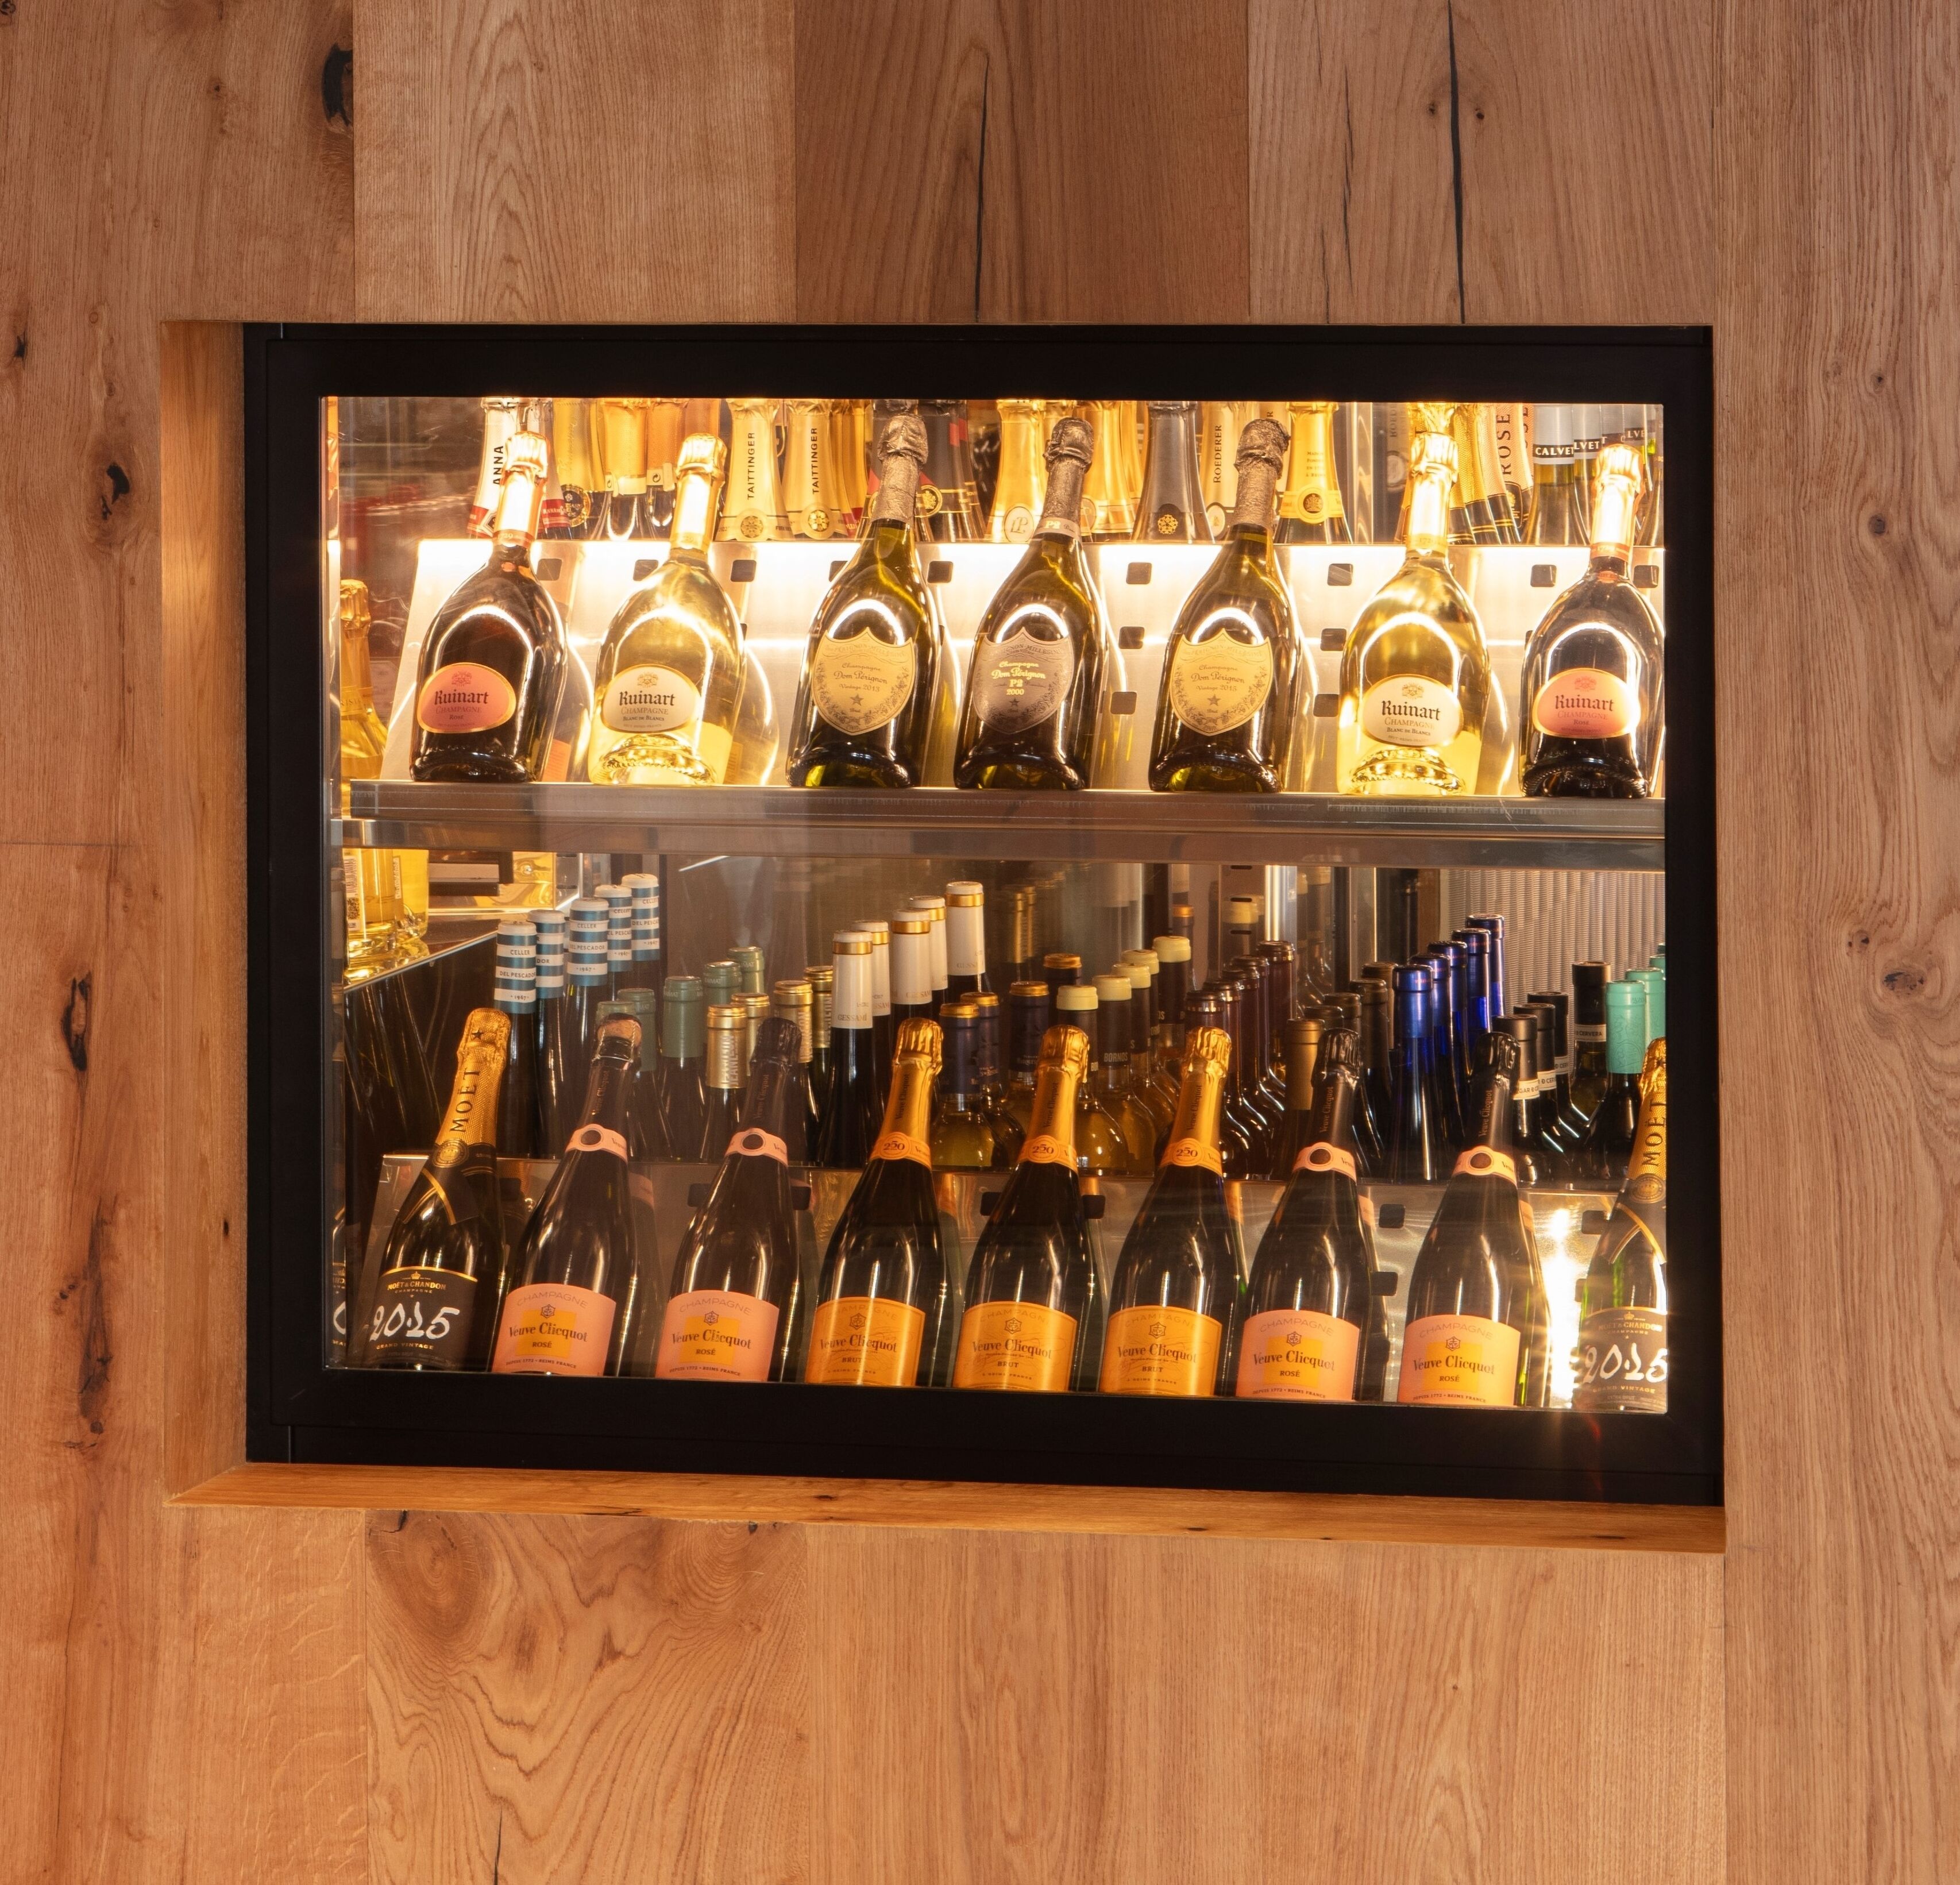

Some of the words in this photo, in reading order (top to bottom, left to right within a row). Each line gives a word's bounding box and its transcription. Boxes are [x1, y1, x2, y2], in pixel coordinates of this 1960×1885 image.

[1574, 441, 1600, 450] LVET
[1213, 425, 1222, 483] ROEDERER
[834, 670, 852, 680] Dom
[854, 670, 888, 684] Pérignon
[991, 669, 1010, 679] Dom
[1191, 673, 1209, 682] Dom
[1210, 671, 1245, 684] Pérignon
[434, 689, 489, 705] Ruinart
[619, 691, 676, 706] Ruinart
[1555, 694, 1614, 711] Ruinart
[621, 706, 669, 715] CHAMPAGNE
[1382, 700, 1441, 720] Ruinart
[1104, 1053, 1128, 1062] BORNOS
[883, 1140, 905, 1151] 250
[1032, 1144, 1054, 1154] 250
[1177, 1147, 1198, 1158] 250
[410, 1281, 446, 1290] CHANDON
[516, 1292, 589, 1309] CHAMPAGNE
[680, 1298, 752, 1316] CHAMPAGNE
[509, 1325, 536, 1338] Veuve
[539, 1322, 588, 1342] Clicquot
[1260, 1318, 1334, 1336] CHAMPAGNE
[1419, 1323, 1494, 1340] CHAMPAGNE
[1623, 1322, 1663, 1332] CHAND
[672, 1332, 700, 1344] Veuve
[703, 1329, 752, 1349] Clicquot
[820, 1338, 847, 1350] Veuve
[849, 1334, 897, 1352] Clicquot
[972, 1341, 1002, 1352] Veuve
[1005, 1338, 1053, 1359] Clicquot
[1118, 1346, 1146, 1358] Veuve
[1149, 1343, 1197, 1363] Clicquot
[556, 1361, 577, 1369] FRANCE
[1253, 1352, 1283, 1366] Veuve
[1286, 1350, 1335, 1371] Clicquot
[1413, 1358, 1442, 1371] Veuve
[1445, 1355, 1495, 1374] Clicquot
[1306, 1390, 1326, 1398] FRANCE
